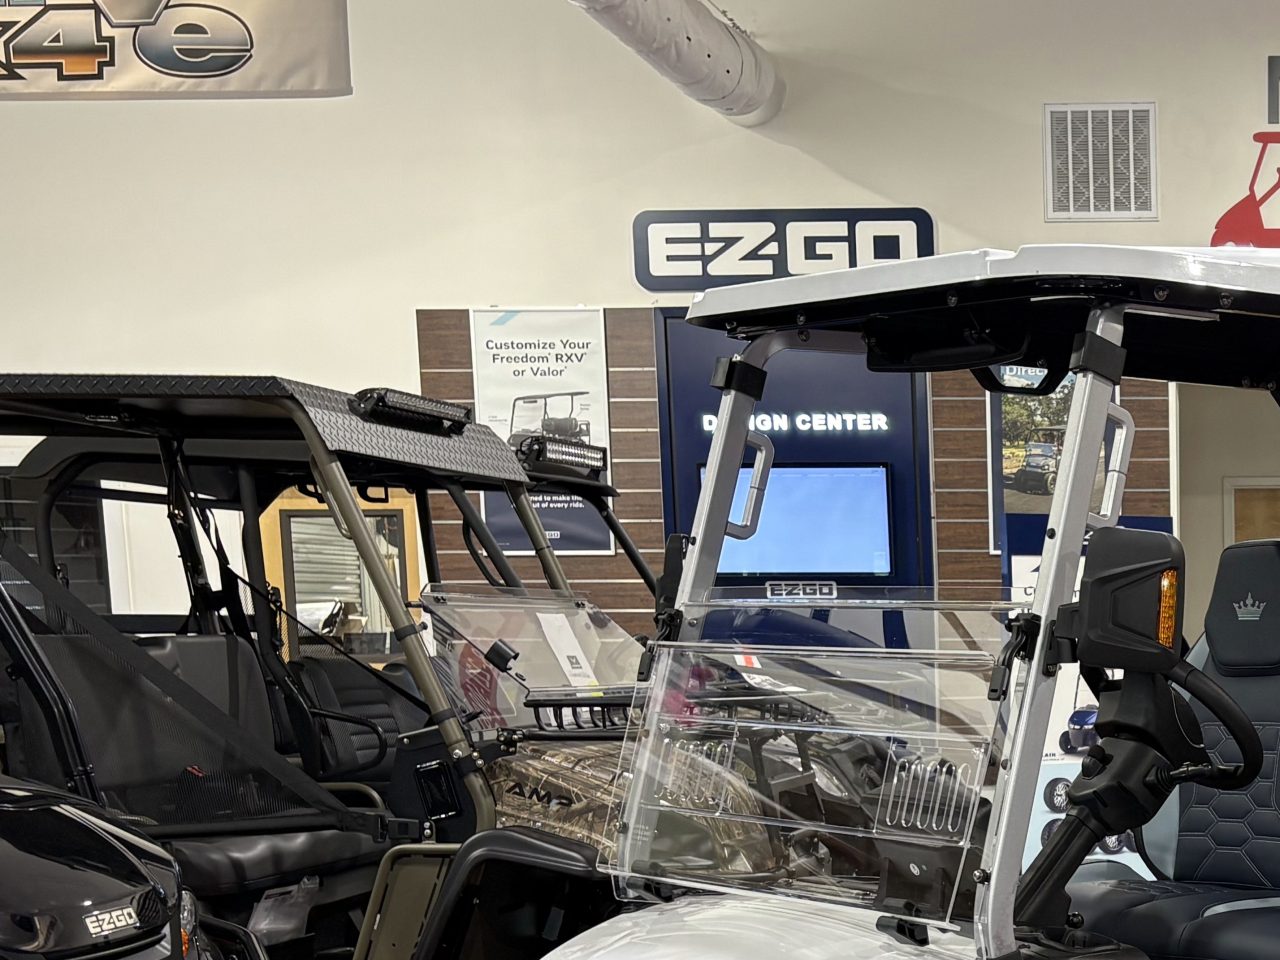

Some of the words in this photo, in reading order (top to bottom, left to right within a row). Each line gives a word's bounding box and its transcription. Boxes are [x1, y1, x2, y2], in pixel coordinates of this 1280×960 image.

[647, 220, 918, 276] EZGO
[485, 339, 556, 350] Customize
[560, 339, 591, 350] Your
[513, 368, 526, 377] or
[703, 413, 788, 434] DIGN
[796, 413, 889, 432] CENTER
[770, 583, 834, 597] EZGO
[85, 907, 139, 934] EZGO
